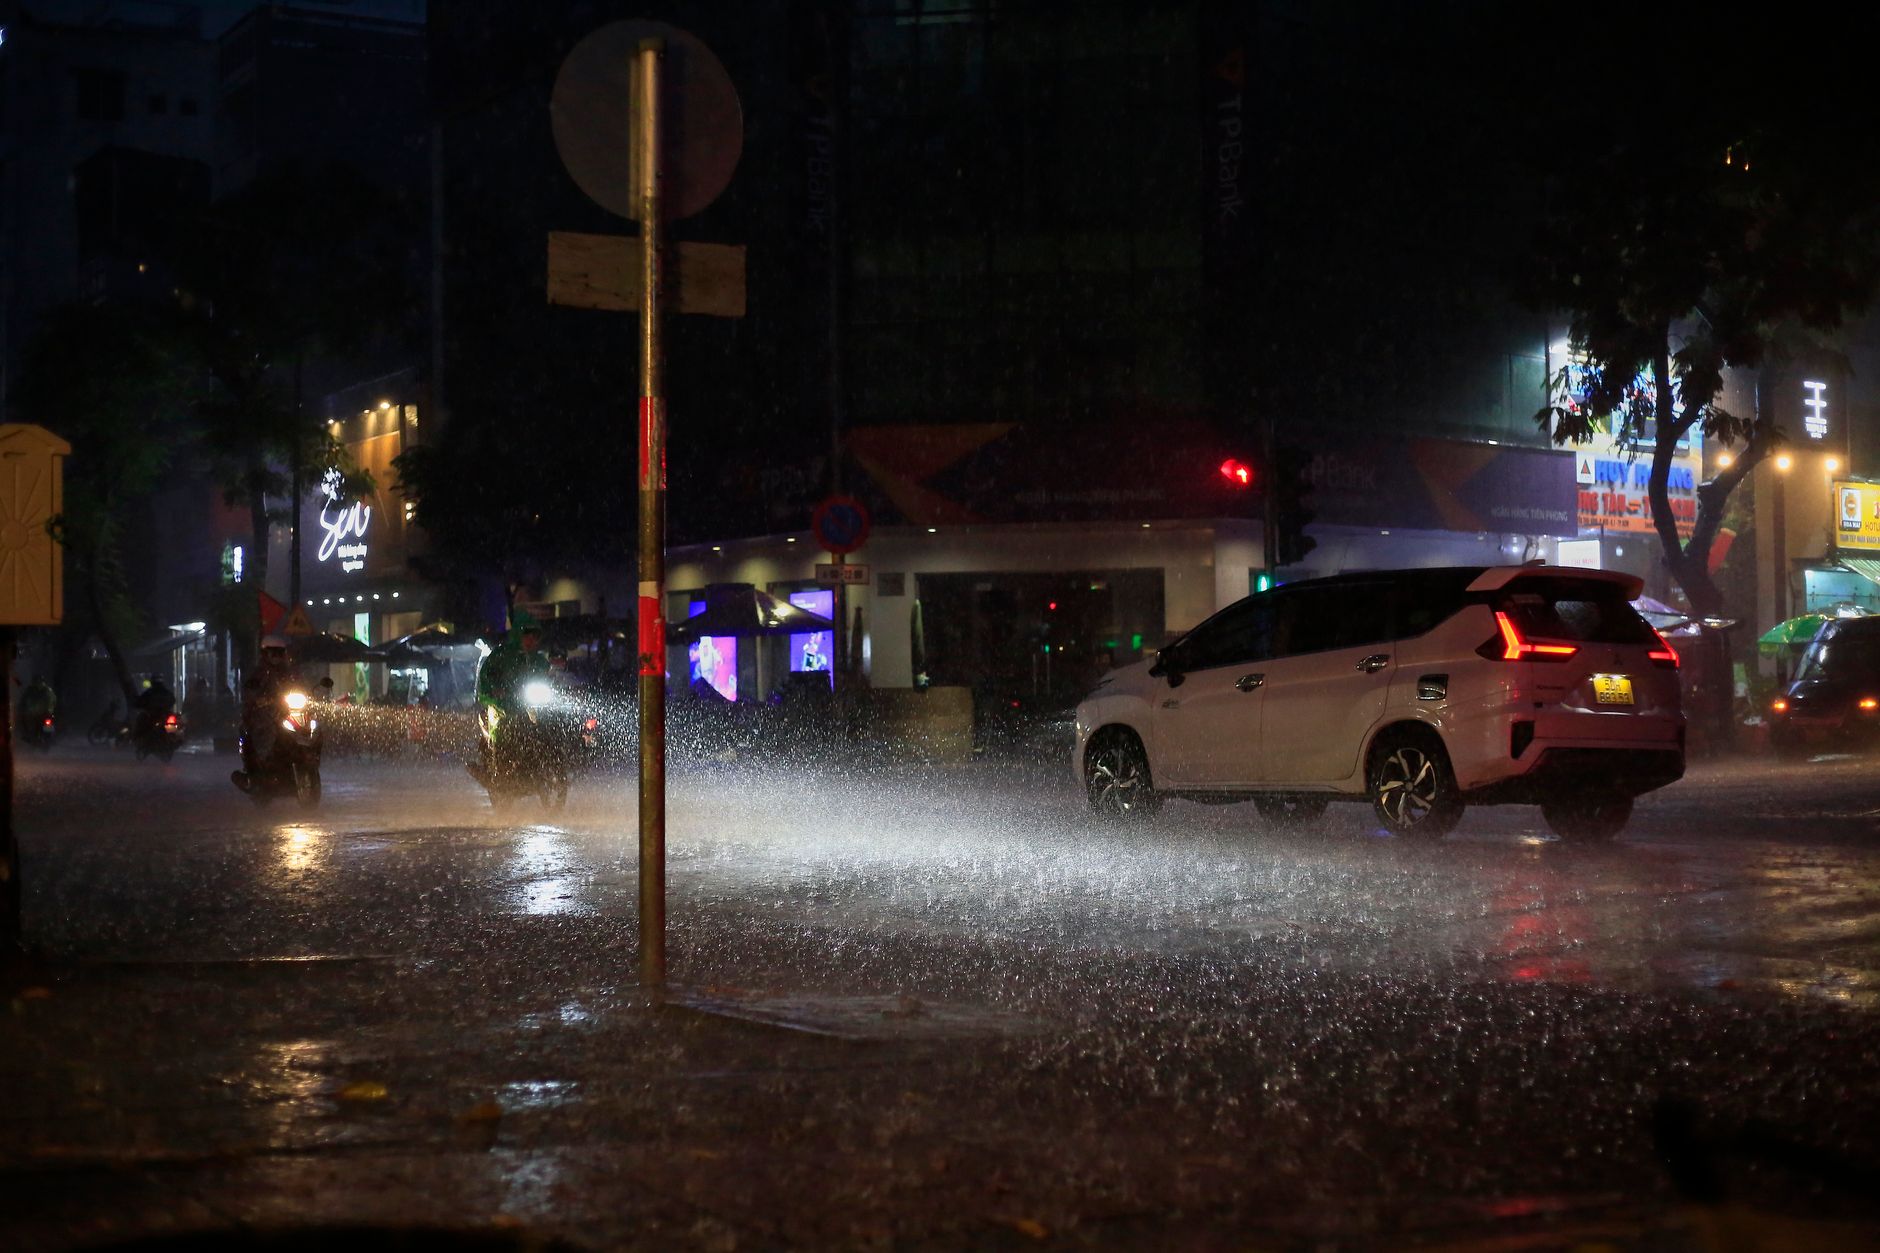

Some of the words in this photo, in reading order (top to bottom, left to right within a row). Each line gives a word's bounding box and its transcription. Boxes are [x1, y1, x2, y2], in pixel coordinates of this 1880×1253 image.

[1218, 94, 1242, 219] TPBank
[1595, 460, 1629, 483] HUY
[1546, 510, 1568, 522] PHONG
